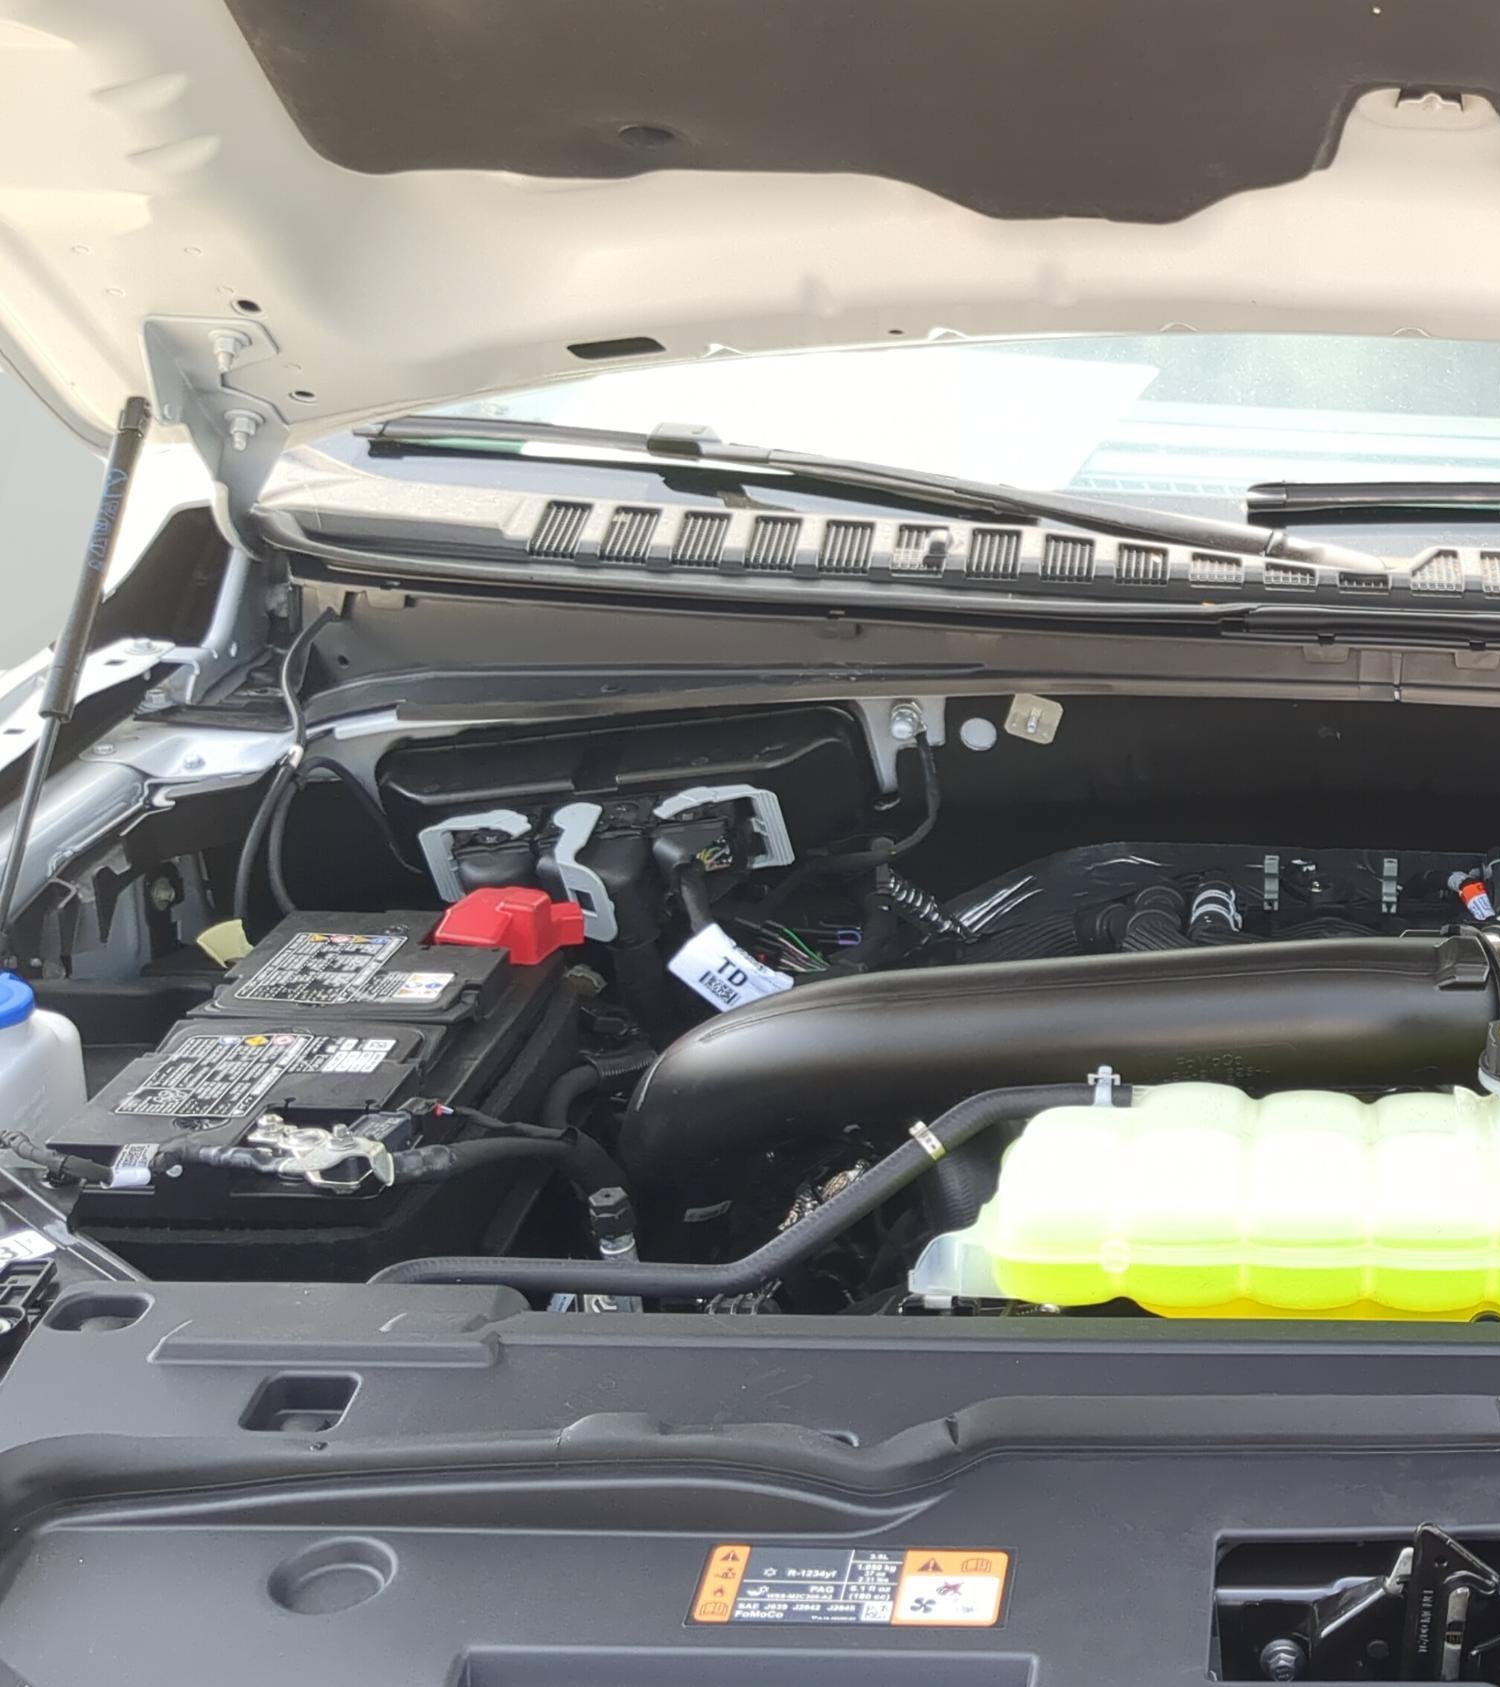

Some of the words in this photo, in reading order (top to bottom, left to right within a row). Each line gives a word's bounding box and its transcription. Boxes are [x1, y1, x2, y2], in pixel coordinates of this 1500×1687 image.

[717, 956, 748, 987] TD
[883, 1565, 896, 1573] kg
[786, 1570, 837, 1578] R-1234yf
[734, 1610, 784, 1618] FoMoCo
